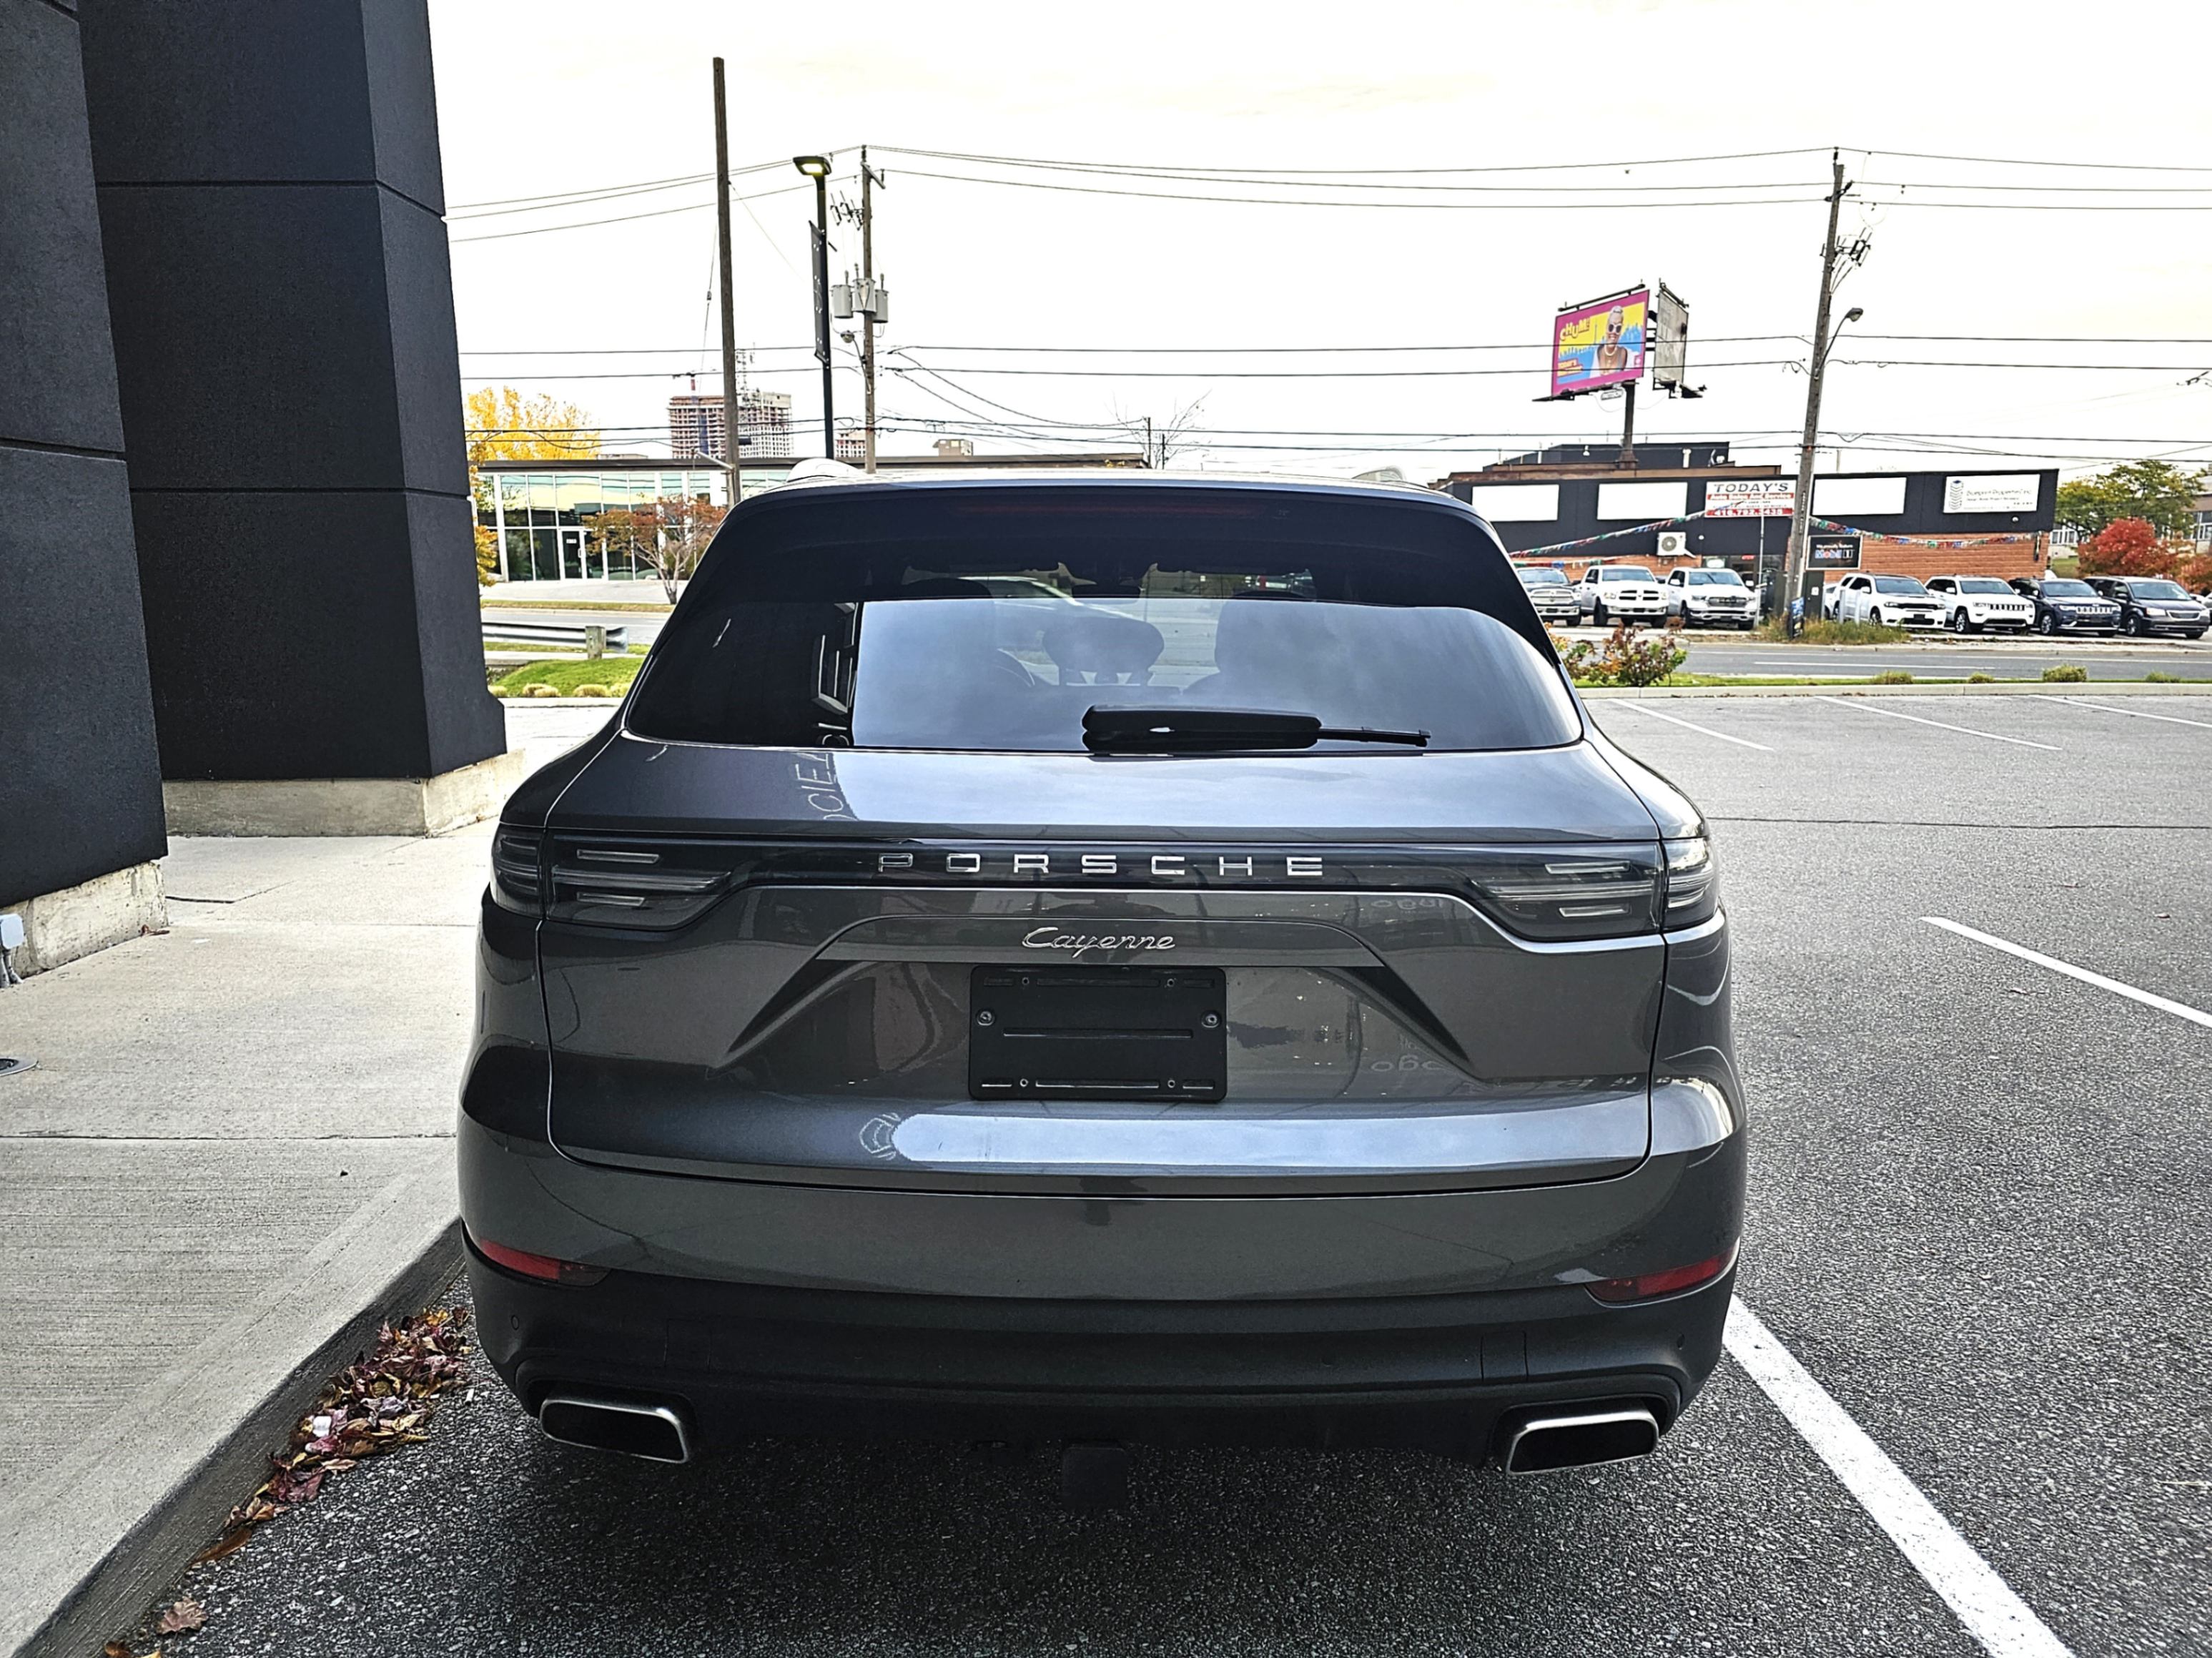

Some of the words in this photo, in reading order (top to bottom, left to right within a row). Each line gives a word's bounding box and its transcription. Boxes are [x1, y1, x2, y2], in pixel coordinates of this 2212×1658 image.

[1714, 483, 1789, 493] TODAY'S
[878, 852, 1323, 877] PORSCHE
[1022, 927, 1175, 959] Cayenne
